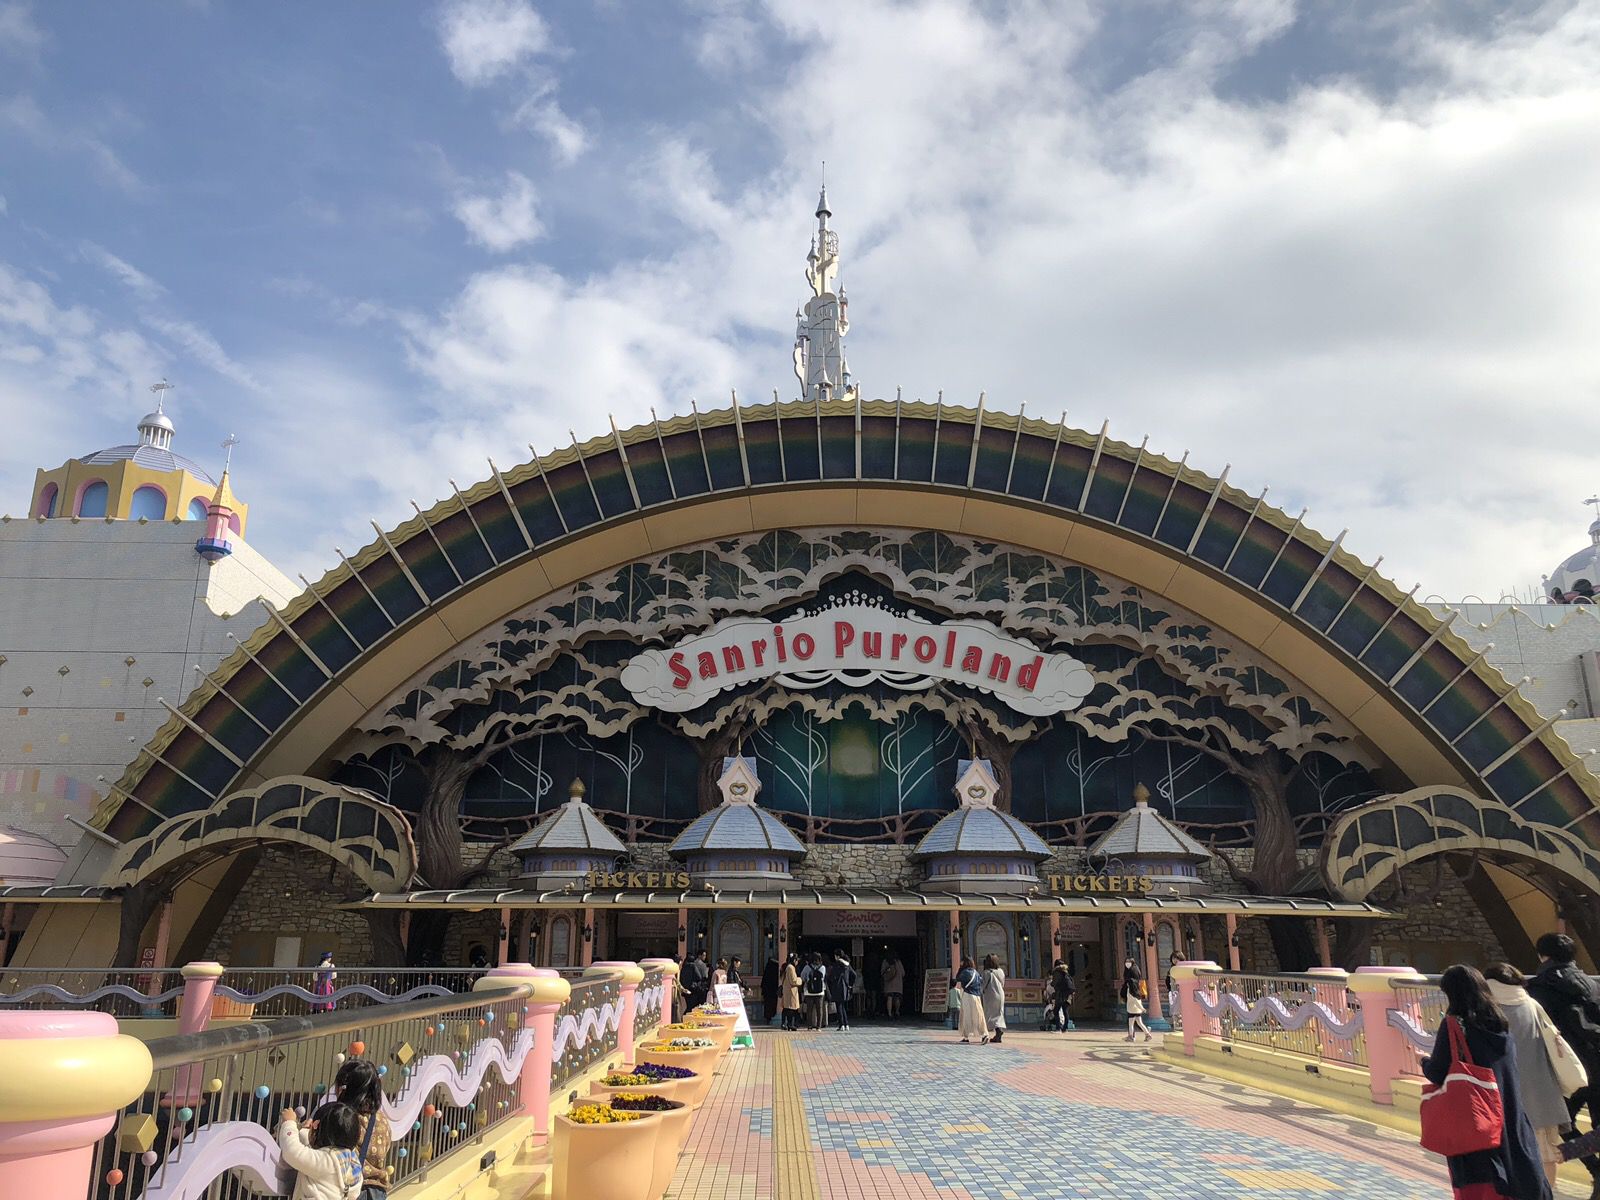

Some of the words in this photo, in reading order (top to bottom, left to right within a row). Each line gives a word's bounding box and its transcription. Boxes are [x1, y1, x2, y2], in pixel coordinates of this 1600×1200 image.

[668, 624, 815, 689] Sanrio
[834, 621, 1044, 691] Puroland
[586, 871, 691, 888] TICKETS
[1047, 874, 1154, 892] TICKETS
